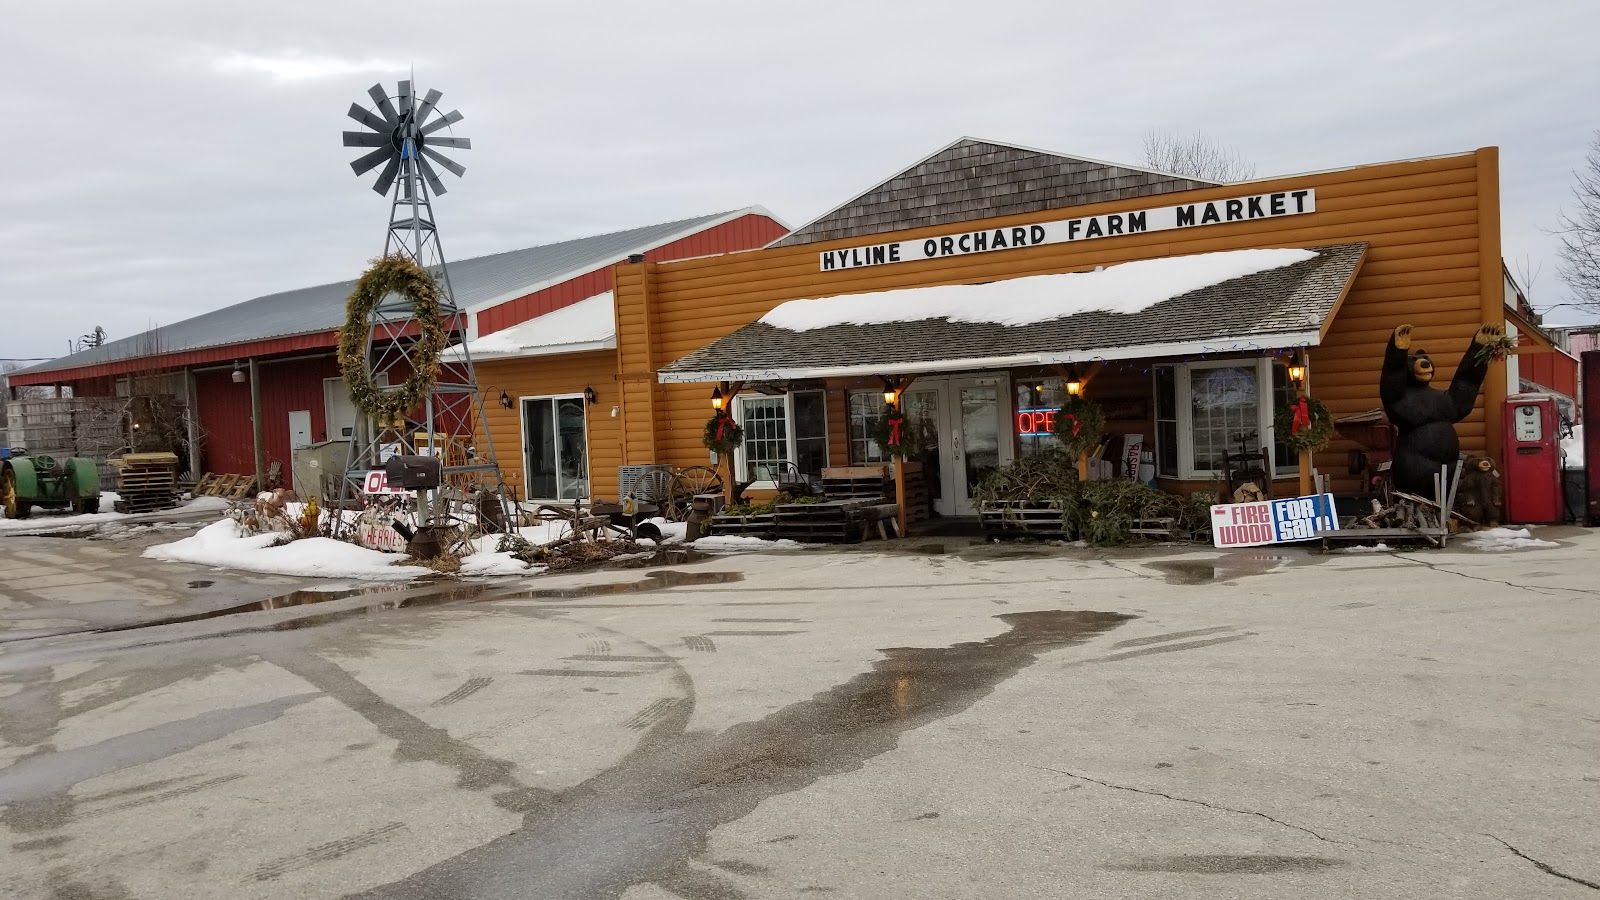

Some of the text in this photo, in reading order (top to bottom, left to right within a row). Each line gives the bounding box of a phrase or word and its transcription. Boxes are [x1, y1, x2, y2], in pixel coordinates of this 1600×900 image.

[823, 190, 1308, 270] HYLINE ORCHARD FARM MARKET
[1018, 412, 1058, 433] OPE
[1276, 499, 1315, 521] FOR
[1219, 524, 1272, 545] WOOD
